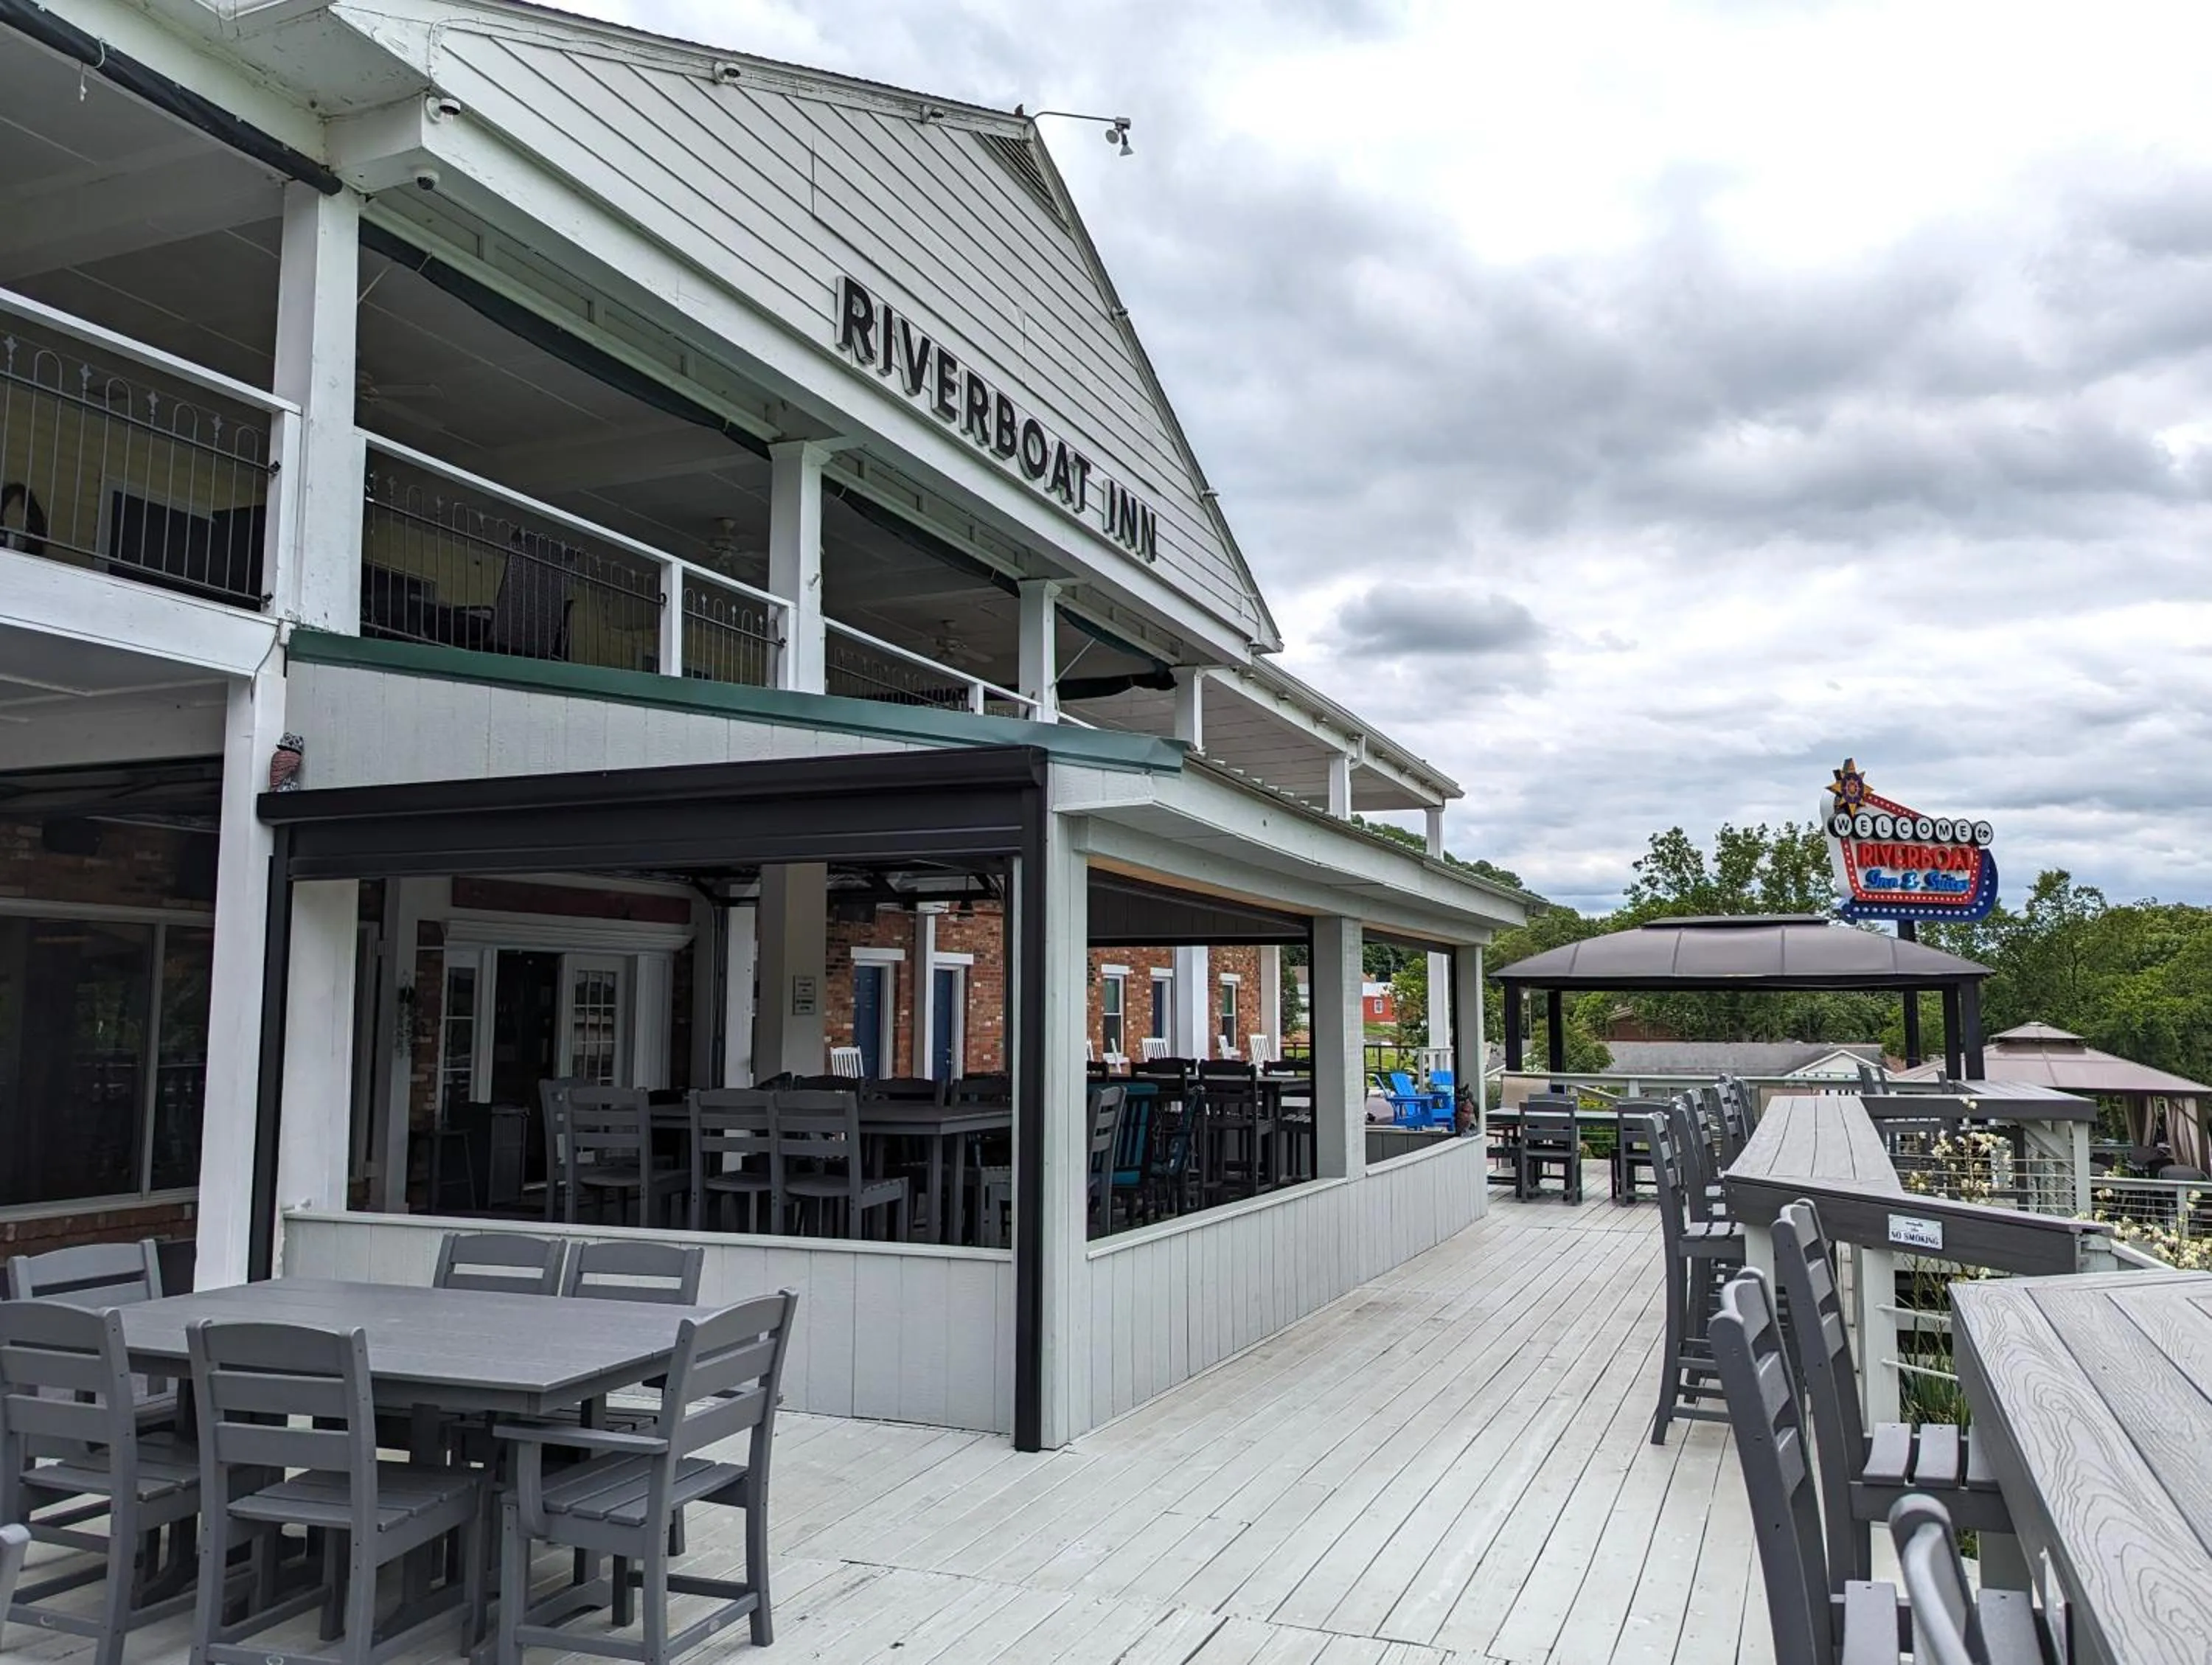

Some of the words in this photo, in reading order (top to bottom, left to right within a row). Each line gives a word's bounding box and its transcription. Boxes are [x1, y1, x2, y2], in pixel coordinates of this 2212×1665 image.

[835, 275, 1091, 514] RIVERBOAT
[1103, 478, 1157, 563] INN
[1836, 817, 1969, 838] WELCOME
[1977, 827, 1990, 839] to
[1857, 842, 1975, 871] RIVERBOAT
[1864, 869, 1899, 889] Inn
[1899, 871, 1920, 889] &
[1891, 1231, 1902, 1240] NO
[1904, 1233, 1939, 1245] SMOKING
